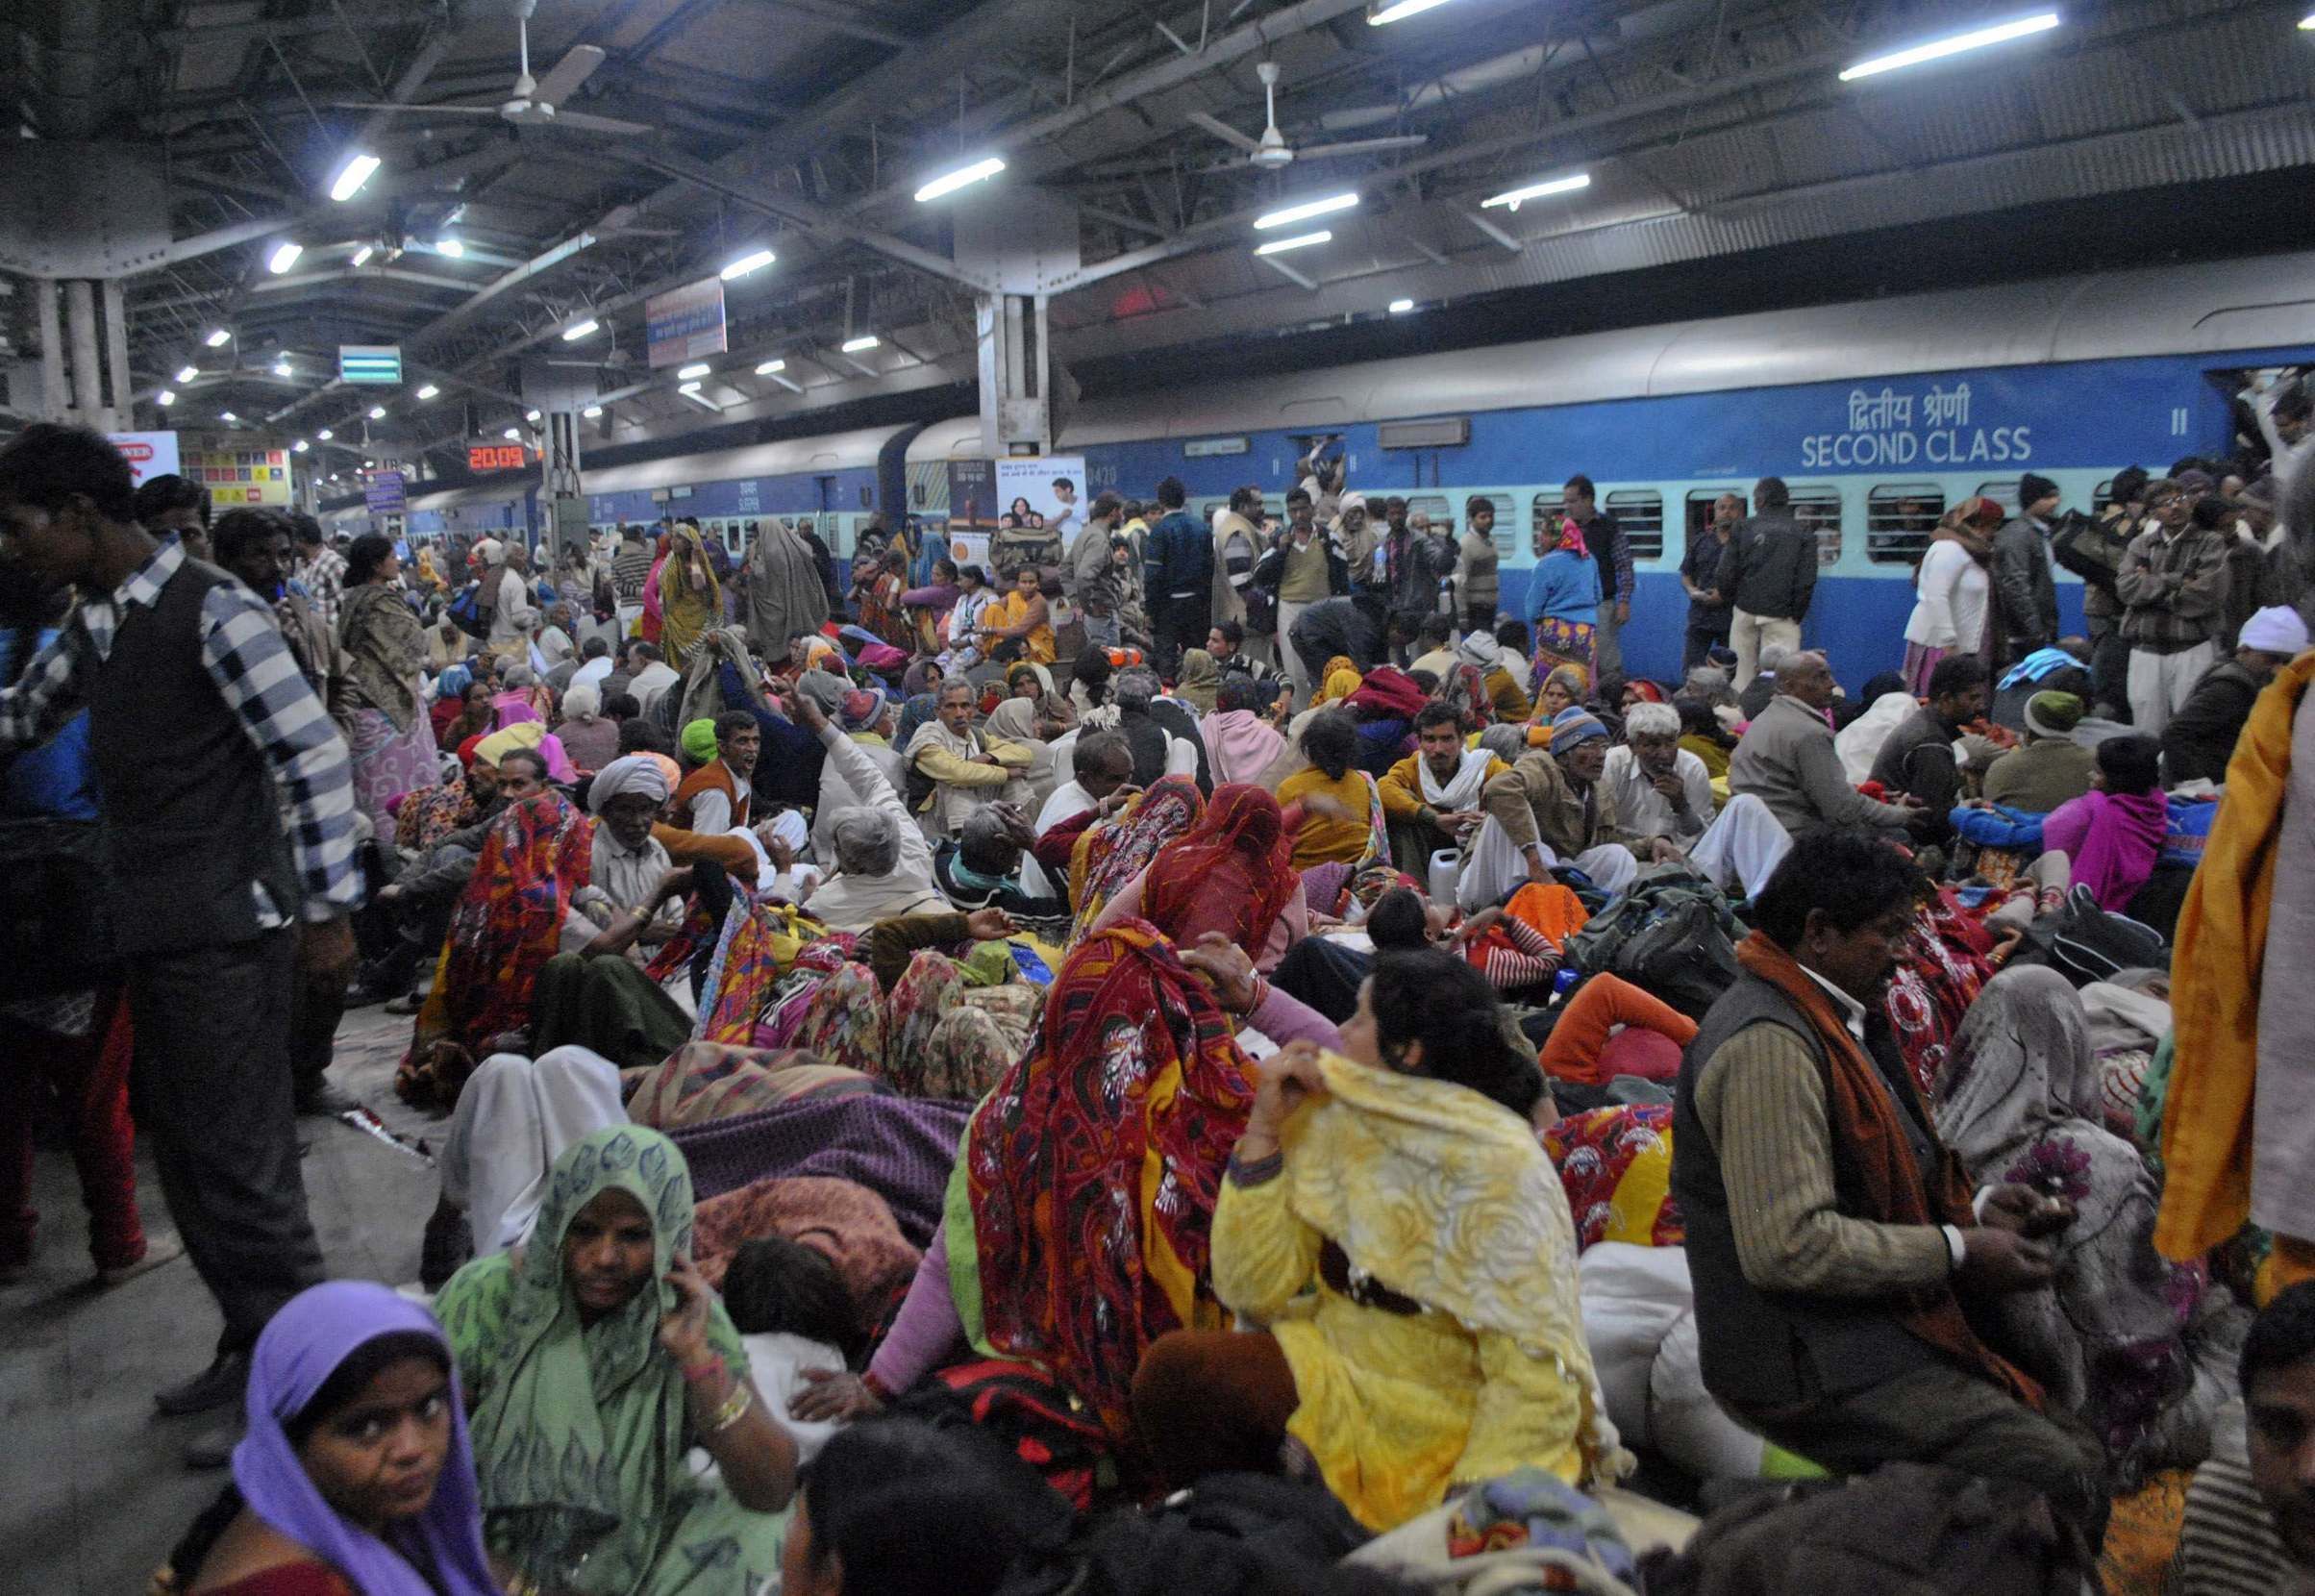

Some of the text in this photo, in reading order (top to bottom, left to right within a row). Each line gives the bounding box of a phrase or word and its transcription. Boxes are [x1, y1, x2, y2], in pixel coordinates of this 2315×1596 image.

[1849, 383, 1971, 431] द्वितीय श्रेणी
[1802, 427, 2031, 466] SECOND CLASS
